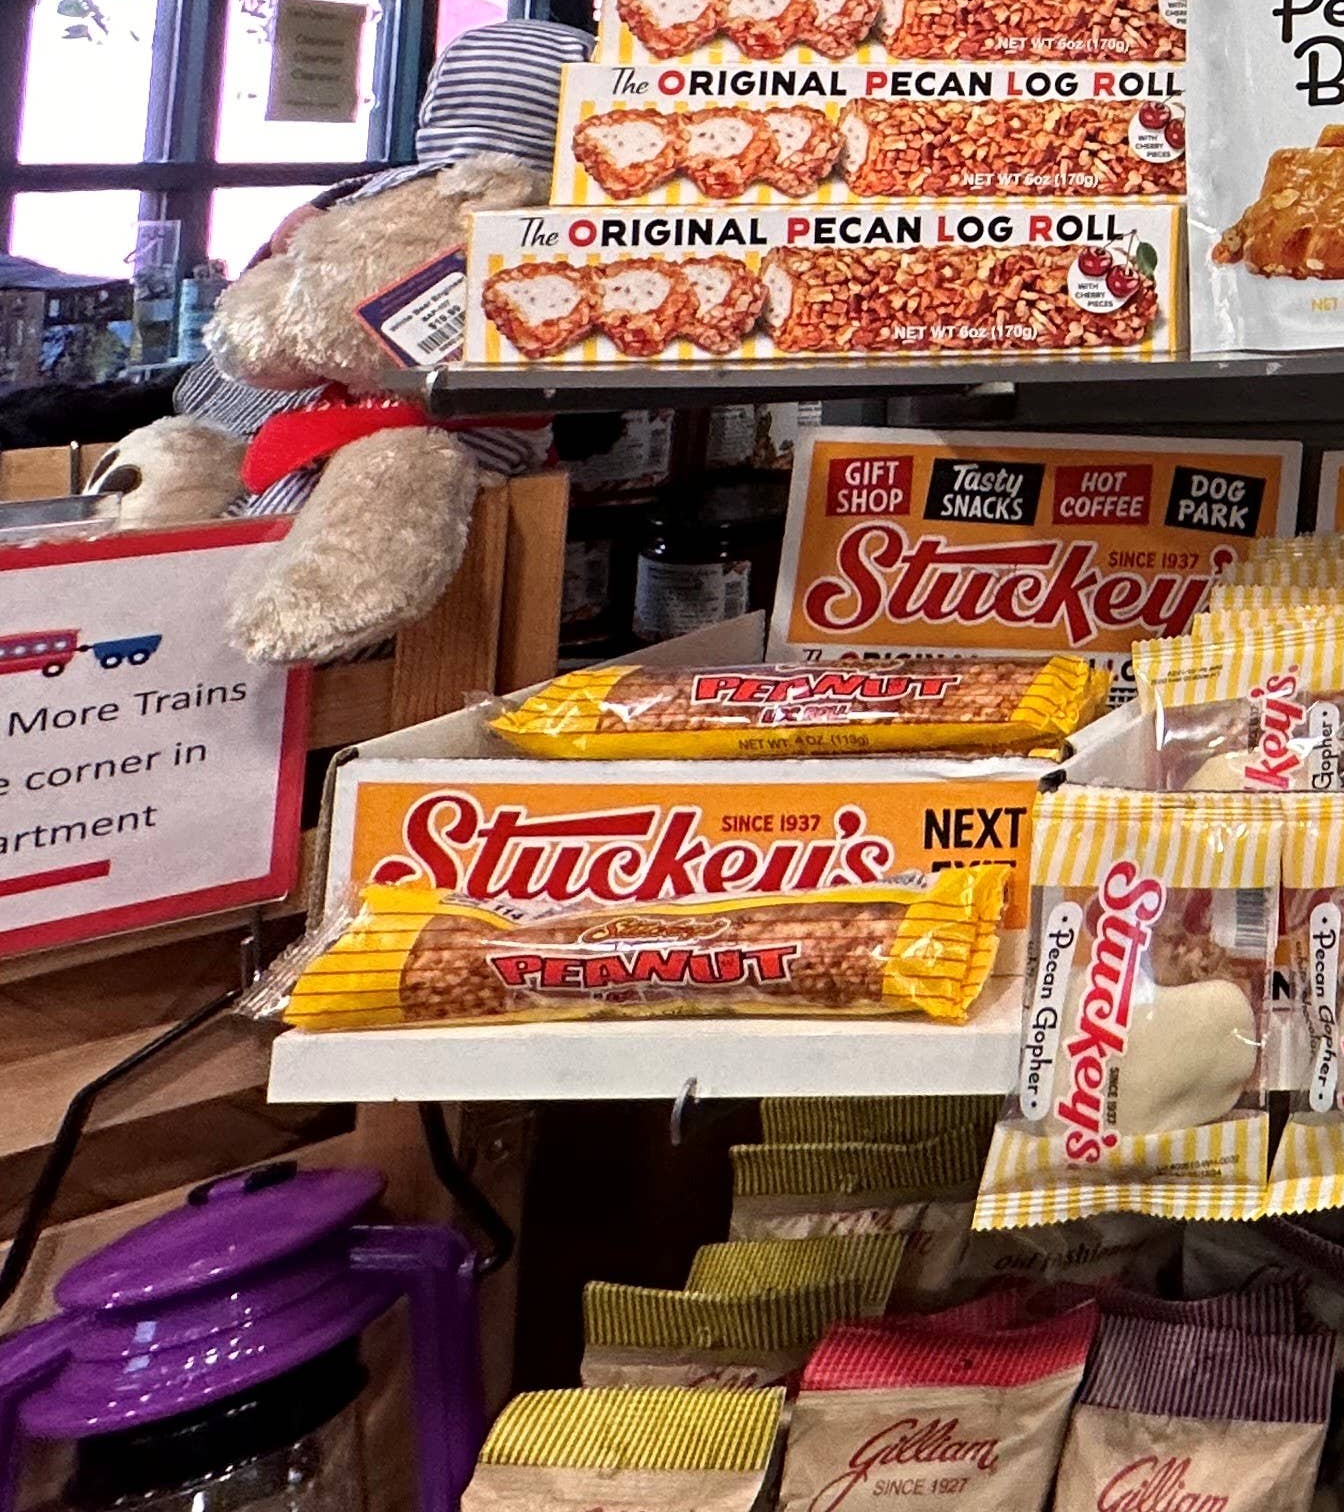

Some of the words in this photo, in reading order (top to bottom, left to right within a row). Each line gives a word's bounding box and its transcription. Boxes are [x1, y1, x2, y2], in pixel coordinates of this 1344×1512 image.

[519, 217, 560, 247] The
[568, 217, 768, 247] ORIGINAL
[786, 216, 922, 245] PECAN
[937, 216, 1013, 244] LOG
[1029, 215, 1124, 243] ROLL
[1074, 290, 1105, 300] CHERRY
[1078, 282, 1099, 292] WITH
[1087, 299, 1113, 309] PIECES
[894, 325, 924, 339] NET
[928, 325, 956, 339] WT
[959, 324, 987, 340] 6oz
[991, 323, 1038, 342] (170g)
[844, 460, 897, 486] GIFT
[952, 464, 1024, 495] Tasty
[1081, 470, 1127, 493] HOT
[1191, 473, 1245, 501] DOG
[836, 487, 904, 514] SHOP
[940, 494, 1024, 522] SNACKS
[1059, 495, 1144, 520] COFFEE
[1178, 498, 1247, 529] PARK
[1109, 551, 1157, 568] SINCE
[1161, 552, 1200, 569] 1937
[694, 674, 960, 704] PEANUT
[8, 699, 120, 737] More
[134, 680, 248, 717] Trains
[25, 749, 162, 791] corner
[174, 742, 208, 766] in
[922, 807, 1028, 849] NEXT
[488, 944, 799, 988] PEANUT
[1039, 927, 1076, 1000] Pecan
[1313, 929, 1336, 998] Pecan
[1055, 860, 1164, 1165] Stuckey's
[1025, 1006, 1058, 1096] Gopher
[1318, 1005, 1337, 1087] Gopher
[811, 1418, 999, 1512] Gilliam
[872, 1479, 928, 1496] SINCE
[931, 1478, 966, 1494] 1927
